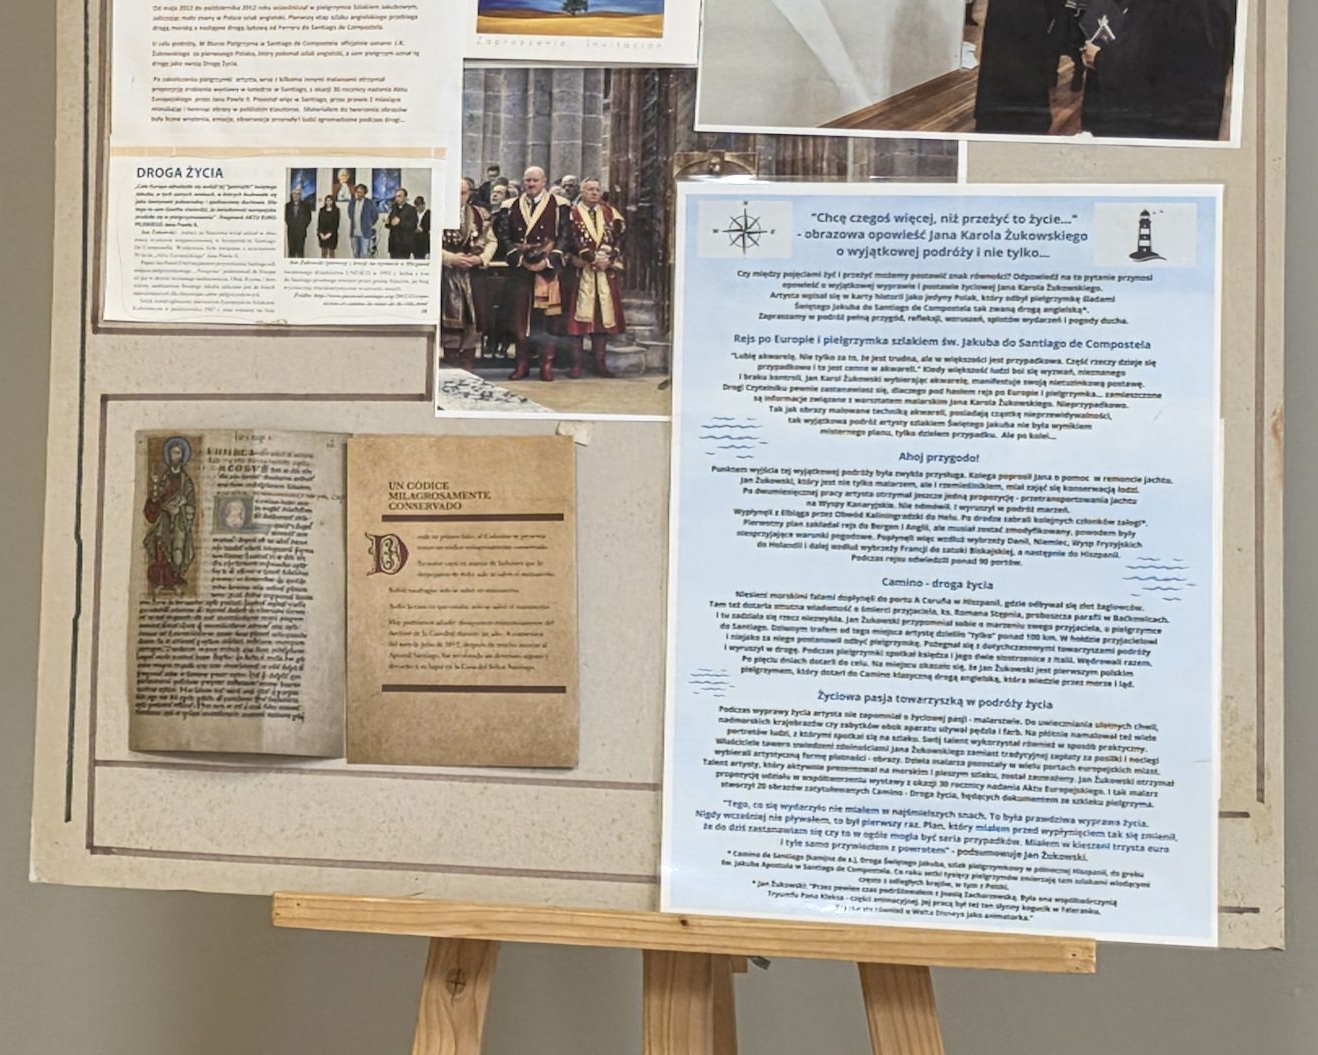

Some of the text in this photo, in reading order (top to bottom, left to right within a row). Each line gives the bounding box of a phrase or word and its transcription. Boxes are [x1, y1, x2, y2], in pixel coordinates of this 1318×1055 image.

[136, 164, 224, 179] DROGA ŻYCIA
[850, 213, 890, 226] czegoś
[893, 213, 937, 226] więcej,
[941, 213, 960, 224] niż
[962, 213, 1010, 226] przeżyć
[1012, 214, 1026, 224] to
[804, 229, 865, 240] obrazowa
[868, 230, 926, 242] opowieść
[928, 230, 956, 240] Jana
[960, 230, 1002, 241] Karola
[1004, 229, 1088, 243] Żukowskiego
[847, 246, 920, 259] wyjątkowej
[923, 247, 974, 259] podróży
[976, 247, 980, 257] i
[984, 247, 1004, 257] nie
[737, 270, 751, 279] Czy
[752, 270, 781, 279] między
[783, 270, 822, 280] pojęciami
[1083, 273, 1116, 282] pytanie
[1117, 273, 1153, 282] przynosi
[997, 283, 1016, 291] Jana
[1017, 283, 1044, 291] Karola
[851, 292, 873, 302] karty
[925, 293, 952, 302] jedyny
[862, 303, 872, 311] do
[734, 334, 1151, 351] Rejs po Europie i pielgrzymka szlakiem św. Jakuba do Santiago de Compostela
[899, 452, 979, 464] Ahoj przygodo!
[388, 479, 450, 491] UN CÓDICE
[388, 491, 492, 501] MILAGROSAMENTE
[388, 502, 462, 512] CONSERVADO
[882, 577, 923, 587] Camino
[932, 578, 963, 590] droga
[966, 579, 994, 591] życia
[817, 690, 862, 704] Życiowa
[864, 693, 892, 705] pasja
[896, 694, 964, 707] towarzyszką
[978, 697, 1023, 710] podróży
[1025, 699, 1053, 711] życia
[765, 801, 778, 812] się
[829, 804, 843, 813] nie
[989, 811, 1001, 820] To
[1023, 850, 1039, 859] Jan
